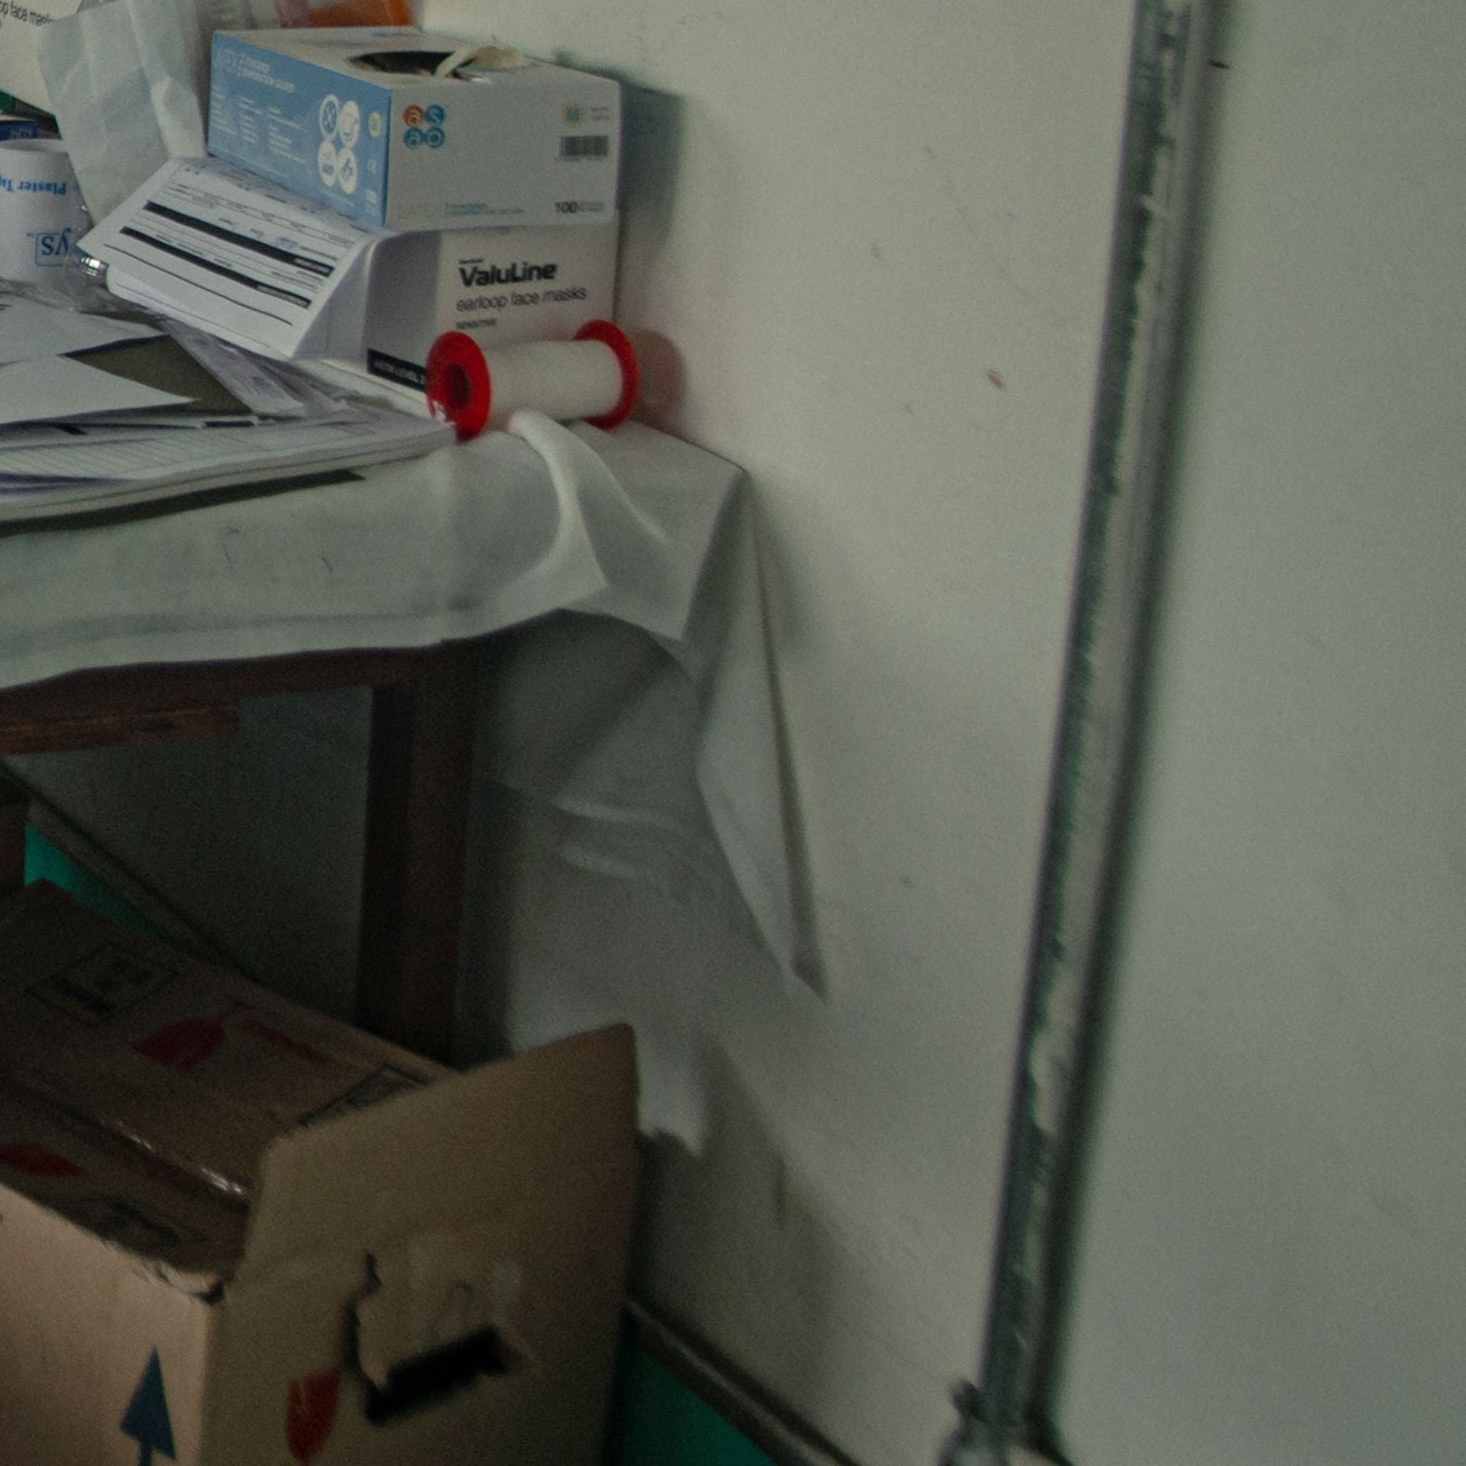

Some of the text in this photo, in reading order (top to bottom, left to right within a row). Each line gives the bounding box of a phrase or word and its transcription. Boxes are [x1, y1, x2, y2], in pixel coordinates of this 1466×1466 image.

[17, 180, 67, 195] Plaster
[458, 261, 557, 288] ValuLine
[456, 285, 587, 312] earloop face masks
